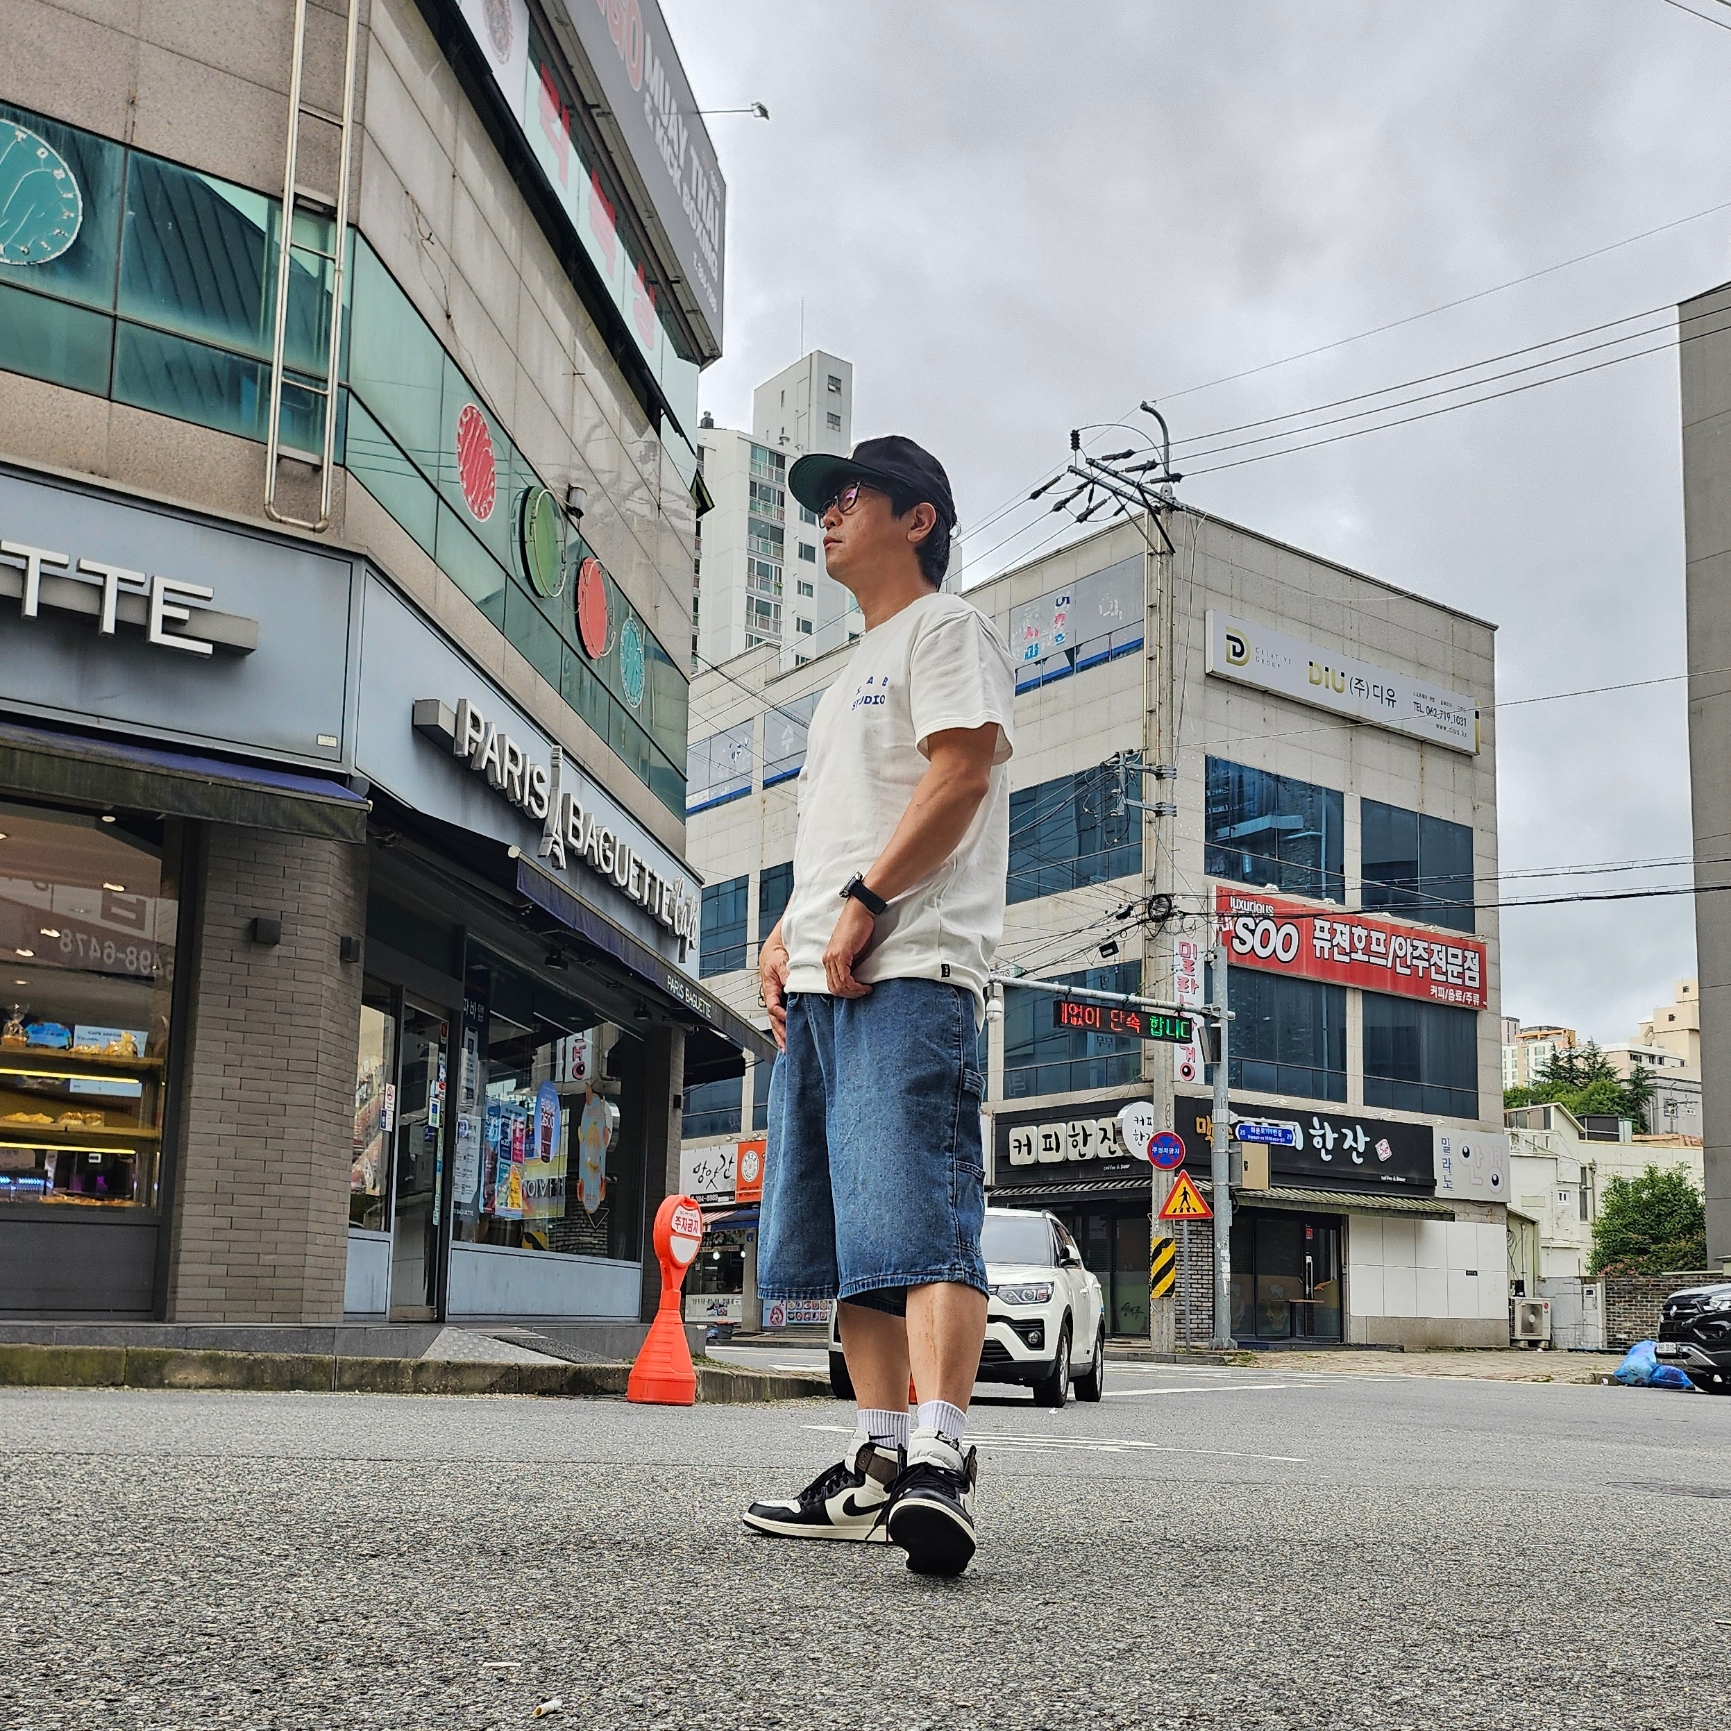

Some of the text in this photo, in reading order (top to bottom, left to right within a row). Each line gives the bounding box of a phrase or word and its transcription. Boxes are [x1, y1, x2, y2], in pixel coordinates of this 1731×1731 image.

[644, 32, 689, 170] MUAY
[690, 144, 719, 253] THAI
[682, 181, 718, 283] BOXING
[852, 694, 886, 711] STUDIO
[455, 698, 549, 820] PARIS
[563, 793, 673, 928] BAGUETTE
[1231, 916, 1300, 963] SOO
[667, 974, 712, 1019] PARIS BAGUETTE
[1430, 985, 1480, 1006] 커피/음료/주류
[1110, 1010, 1141, 1034] 단속
[1441, 1136, 1454, 1193] 밀라노
[675, 1216, 698, 1234] 주차금지
